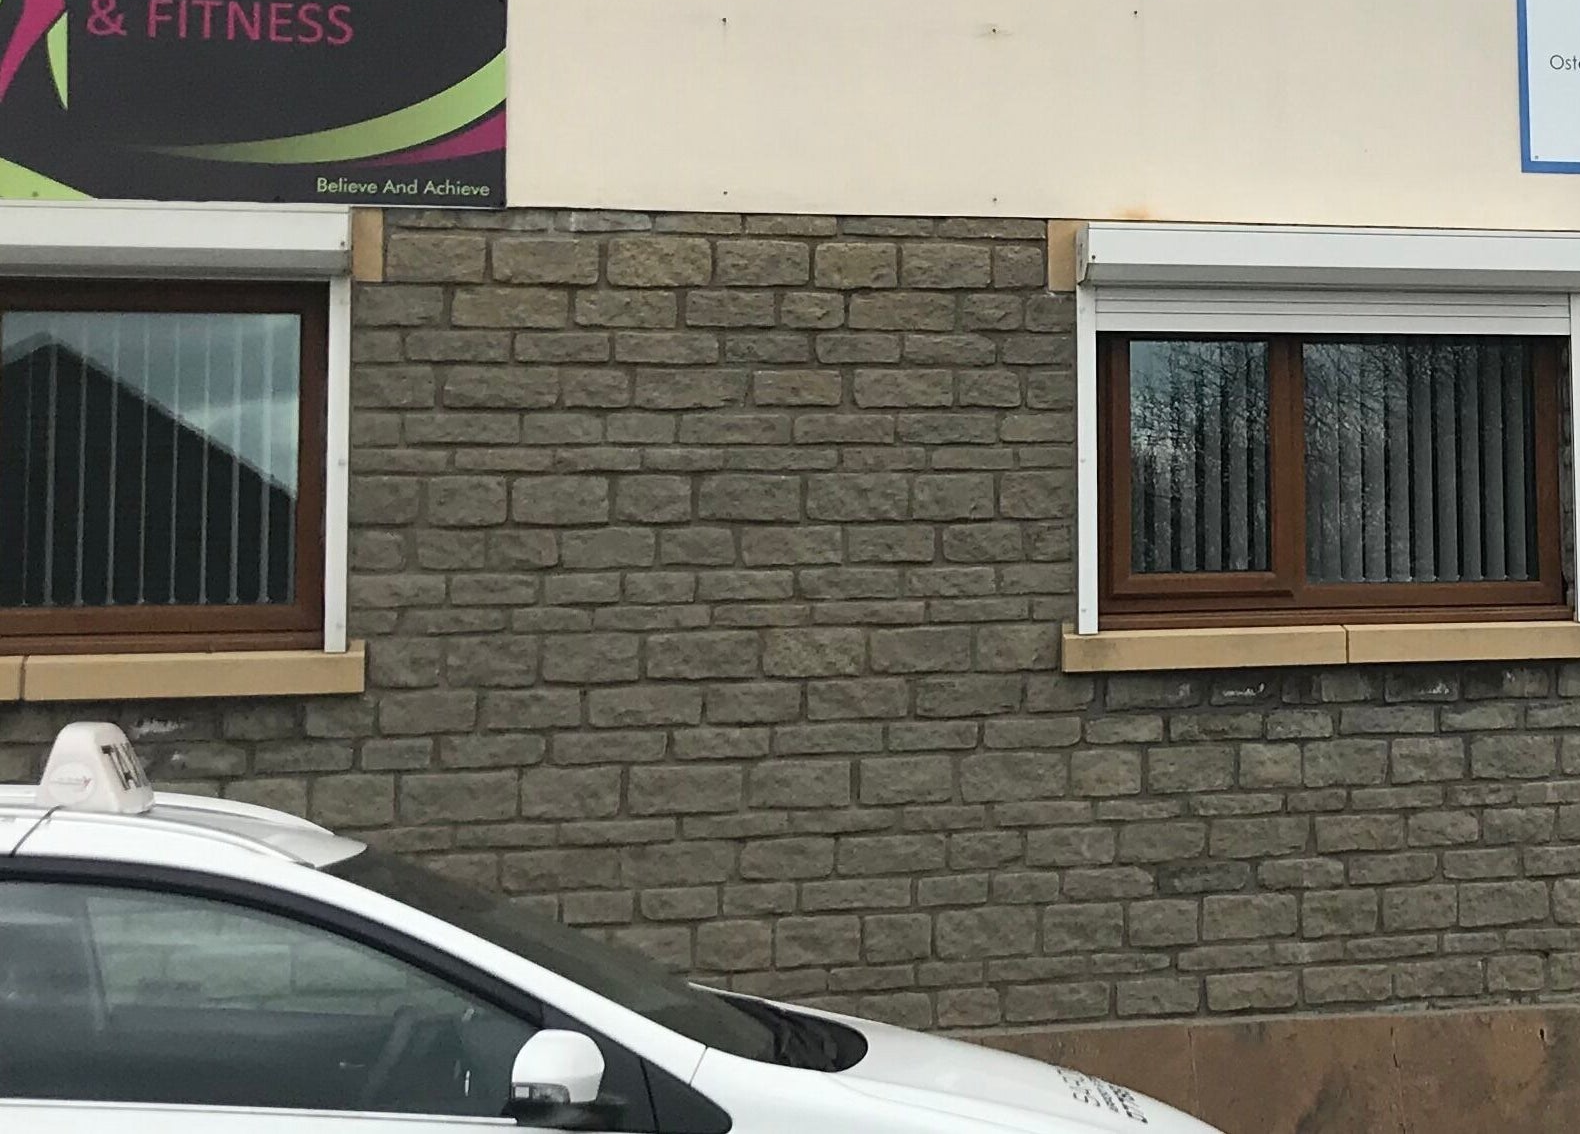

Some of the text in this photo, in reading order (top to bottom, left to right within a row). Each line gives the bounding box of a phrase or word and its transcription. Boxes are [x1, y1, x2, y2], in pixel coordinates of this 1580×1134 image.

[316, 177, 490, 196] Believe And Achieve
